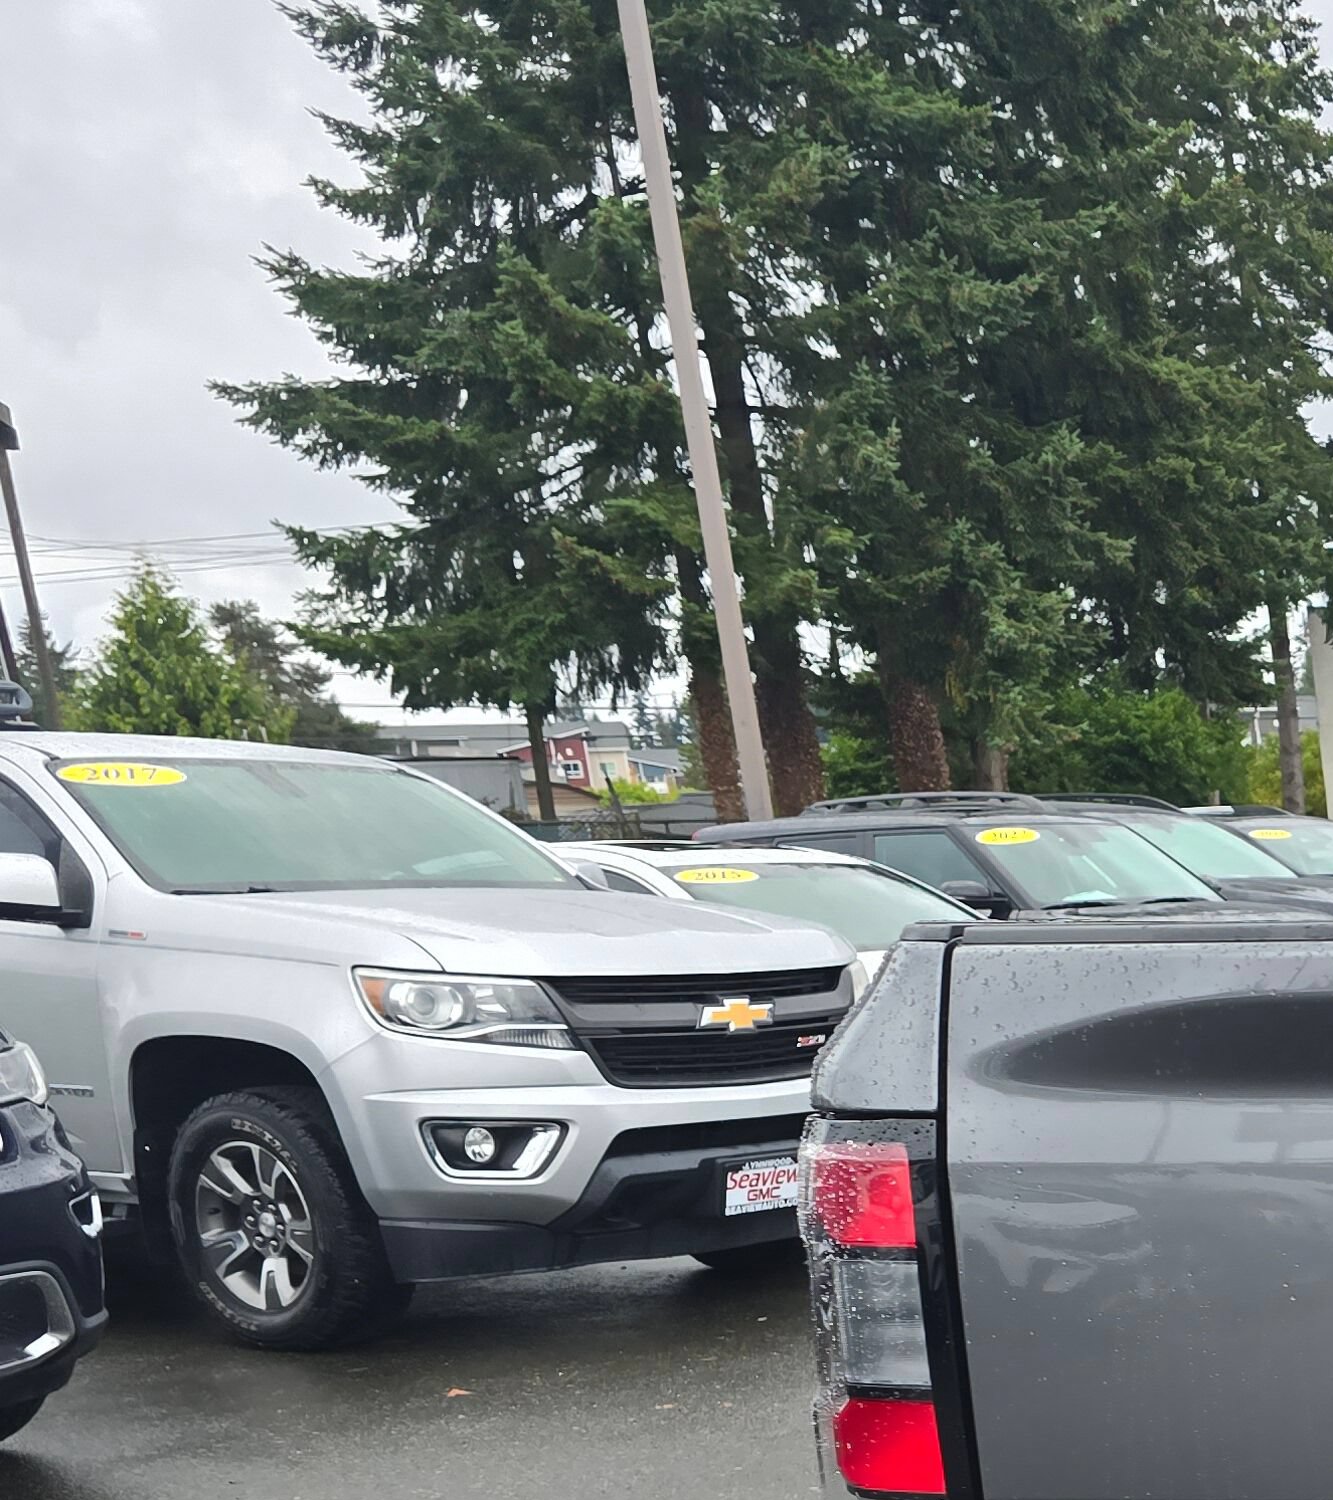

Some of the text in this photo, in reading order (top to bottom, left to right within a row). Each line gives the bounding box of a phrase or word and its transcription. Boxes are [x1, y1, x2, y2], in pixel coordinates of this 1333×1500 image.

[81, 767, 158, 781] 2017
[726, 1168, 798, 1190] Seaview
[747, 1186, 781, 1201] GMC
[725, 1199, 798, 1216] SEAVIEWAUTO.CO
